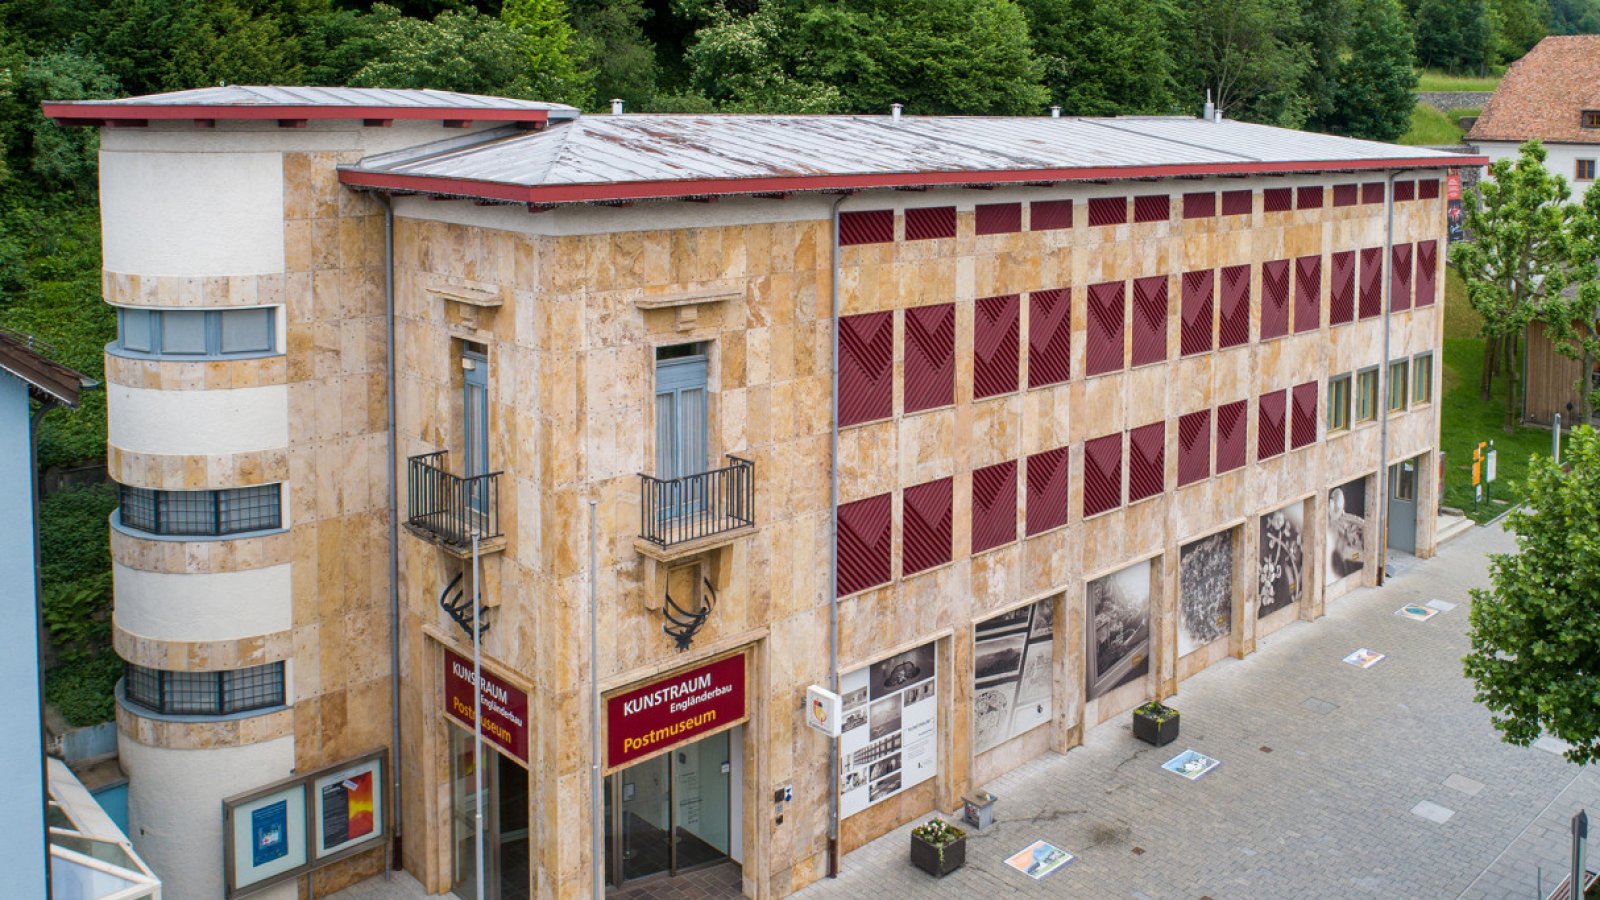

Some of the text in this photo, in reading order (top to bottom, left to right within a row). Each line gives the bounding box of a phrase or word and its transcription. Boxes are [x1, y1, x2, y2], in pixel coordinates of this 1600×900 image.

[453, 661, 508, 705] KUNSRAUM
[624, 673, 711, 717] KUNSTRAUM
[670, 684, 733, 713] Engländerbau
[481, 694, 523, 727] Engländerbau
[624, 709, 717, 753] Postmuseum
